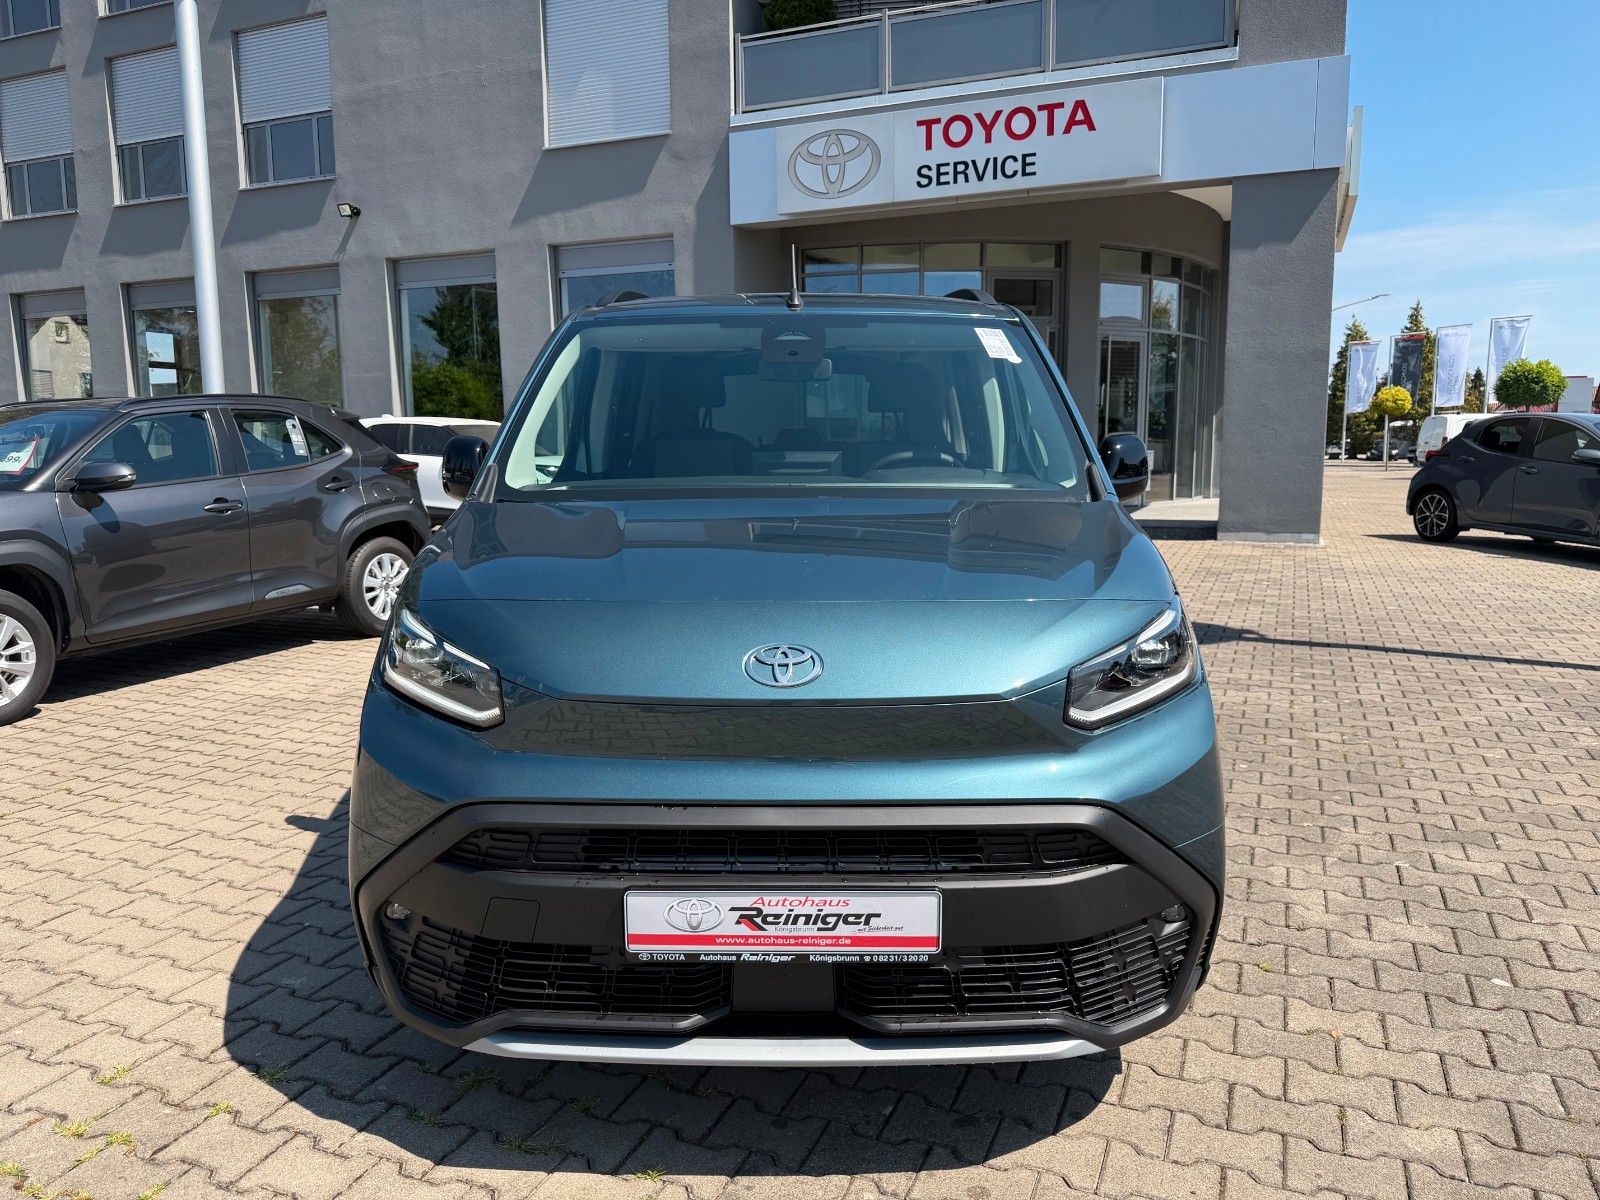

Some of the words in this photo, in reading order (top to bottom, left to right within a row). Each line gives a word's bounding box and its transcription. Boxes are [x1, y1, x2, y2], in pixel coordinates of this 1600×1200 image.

[916, 99, 1097, 151] TOYOTA
[916, 152, 1037, 188] SERVICE
[749, 896, 851, 907] Autohaus
[728, 907, 882, 931] Reiniger
[715, 936, 851, 945] www.autohaus-reiniger.de
[652, 953, 685, 961] TOYOTA
[699, 953, 737, 961] Autohaus
[740, 953, 796, 962] Reiniger
[809, 954, 860, 962] Königsbrunn
